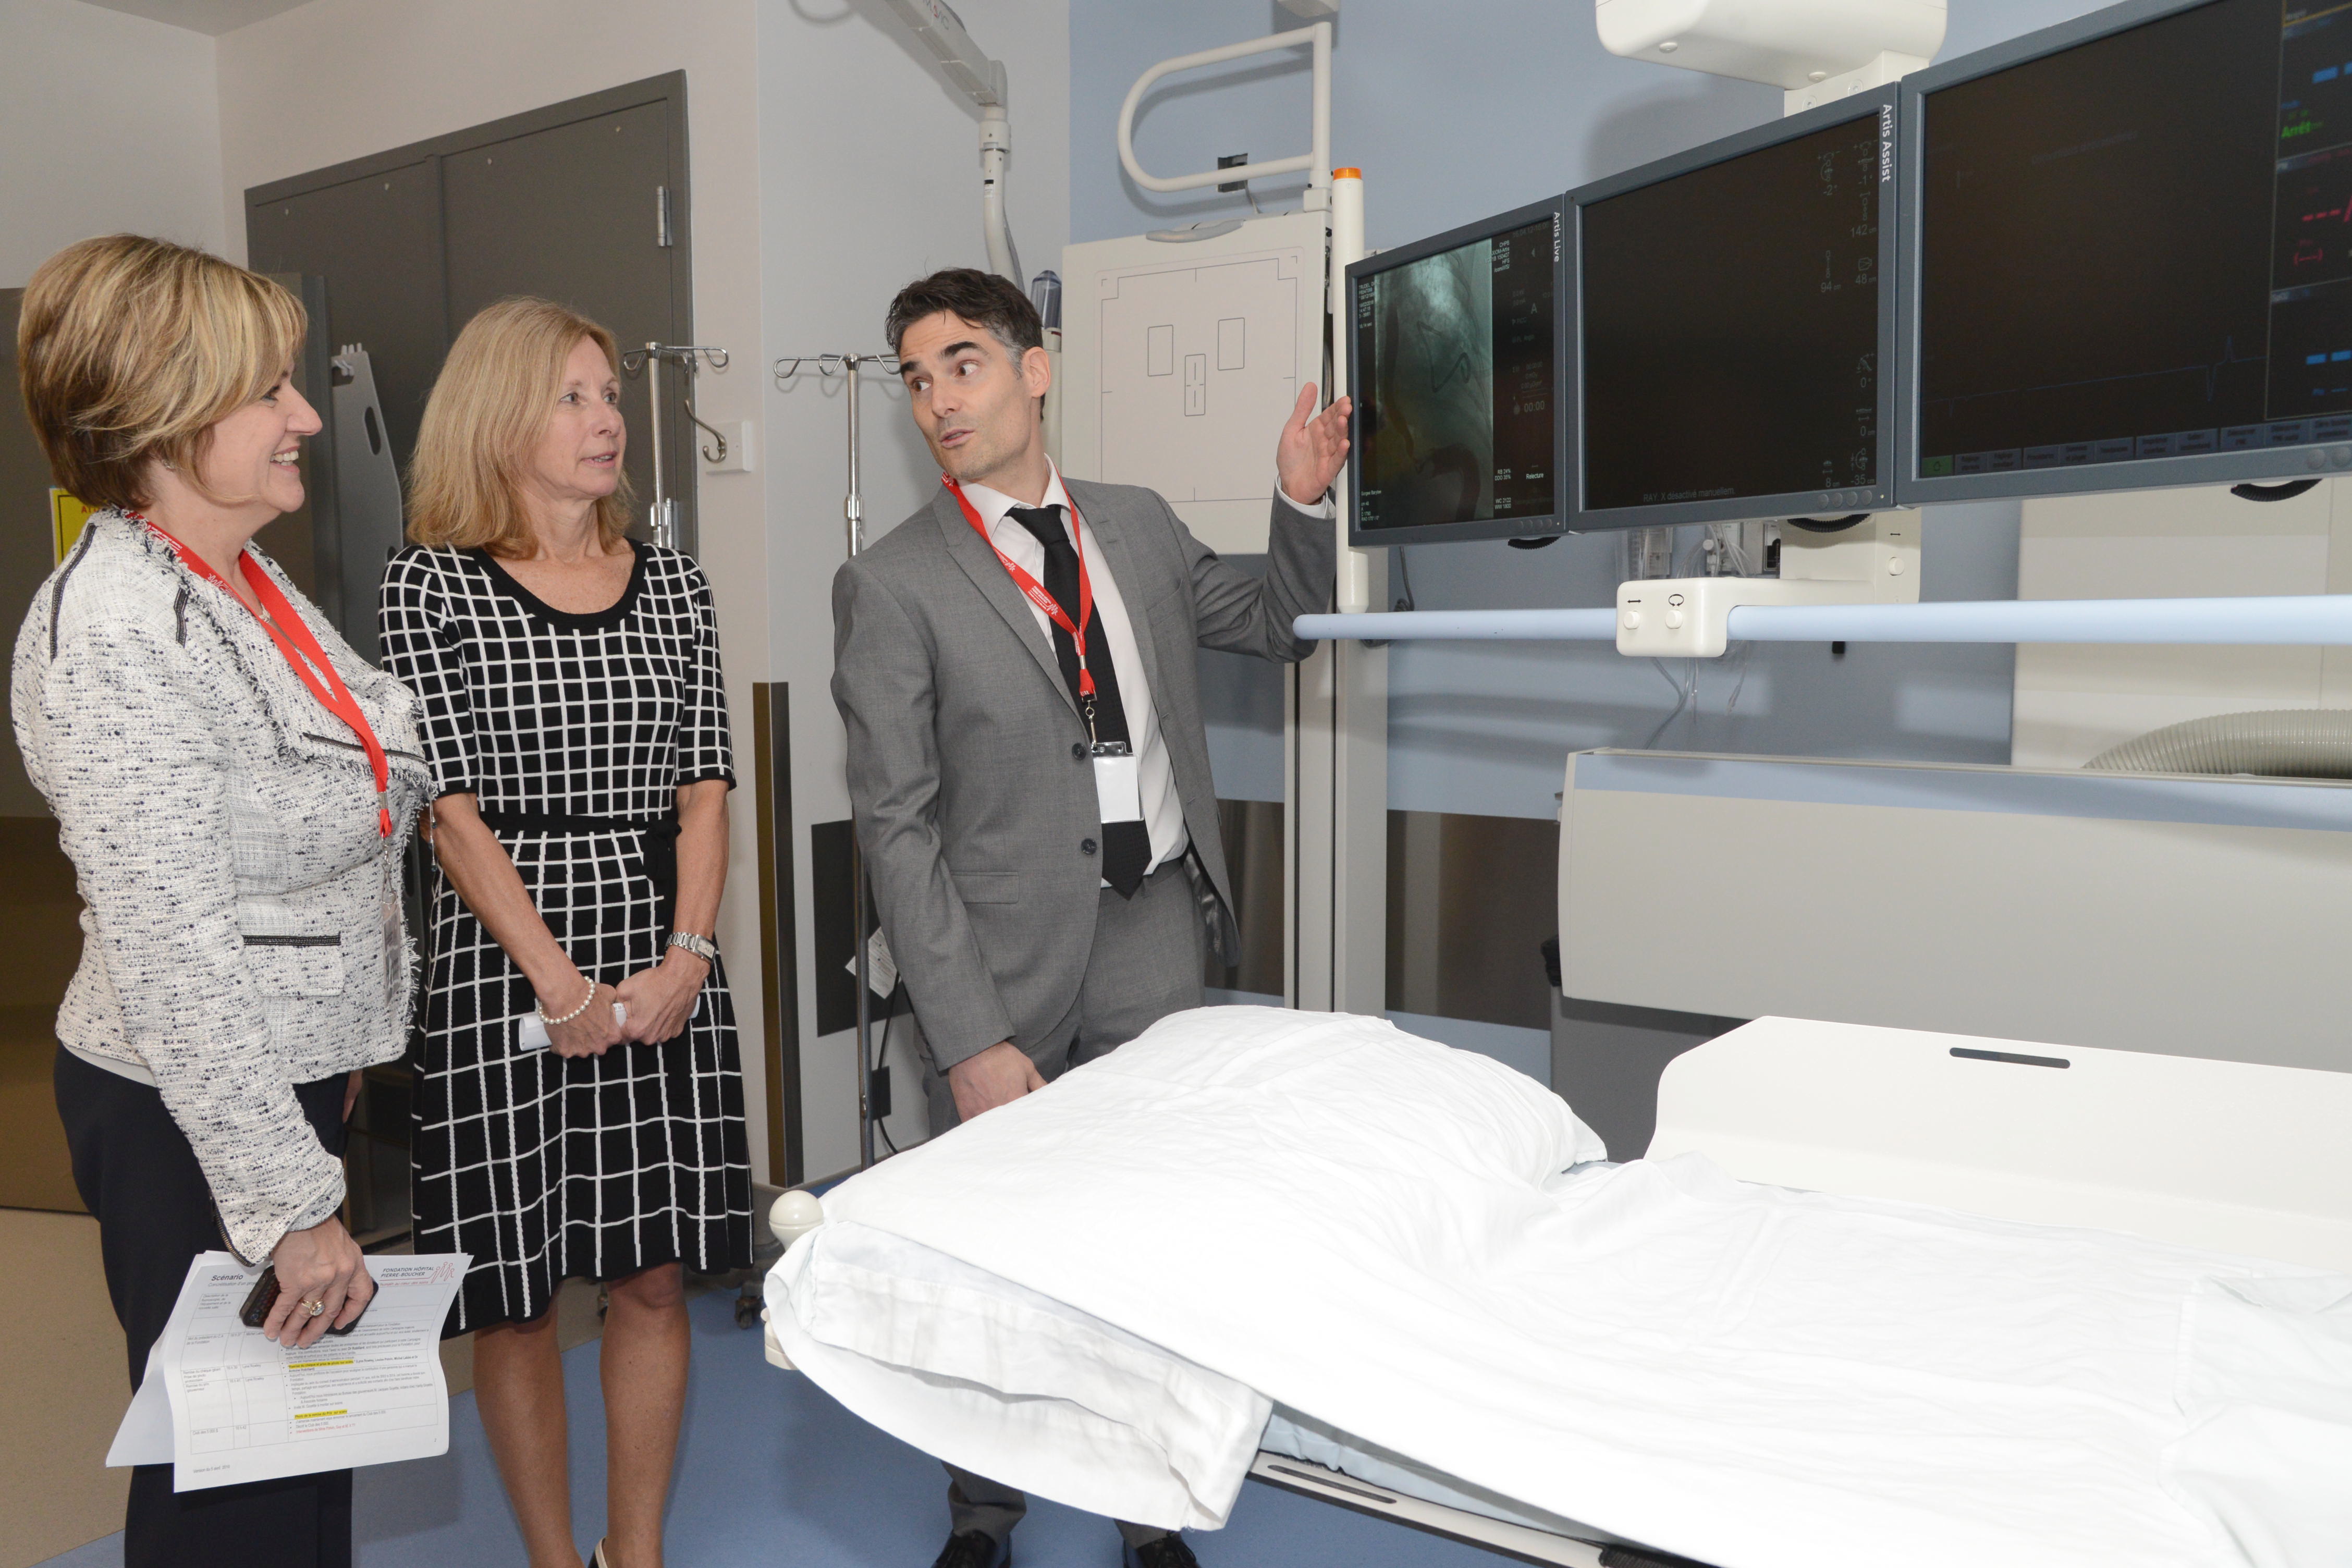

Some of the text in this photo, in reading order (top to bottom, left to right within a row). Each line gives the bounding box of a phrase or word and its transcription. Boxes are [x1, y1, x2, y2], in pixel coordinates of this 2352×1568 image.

[1882, 104, 1893, 182] Artis Assist
[1851, 225, 1867, 238] 142
[1855, 274, 1867, 285] 48
[1821, 283, 1832, 292] 94
[1531, 303, 1537, 314] A
[1524, 400, 1545, 413] 00:00
[1860, 426, 1866, 436] 0
[1826, 477, 1831, 488] 8
